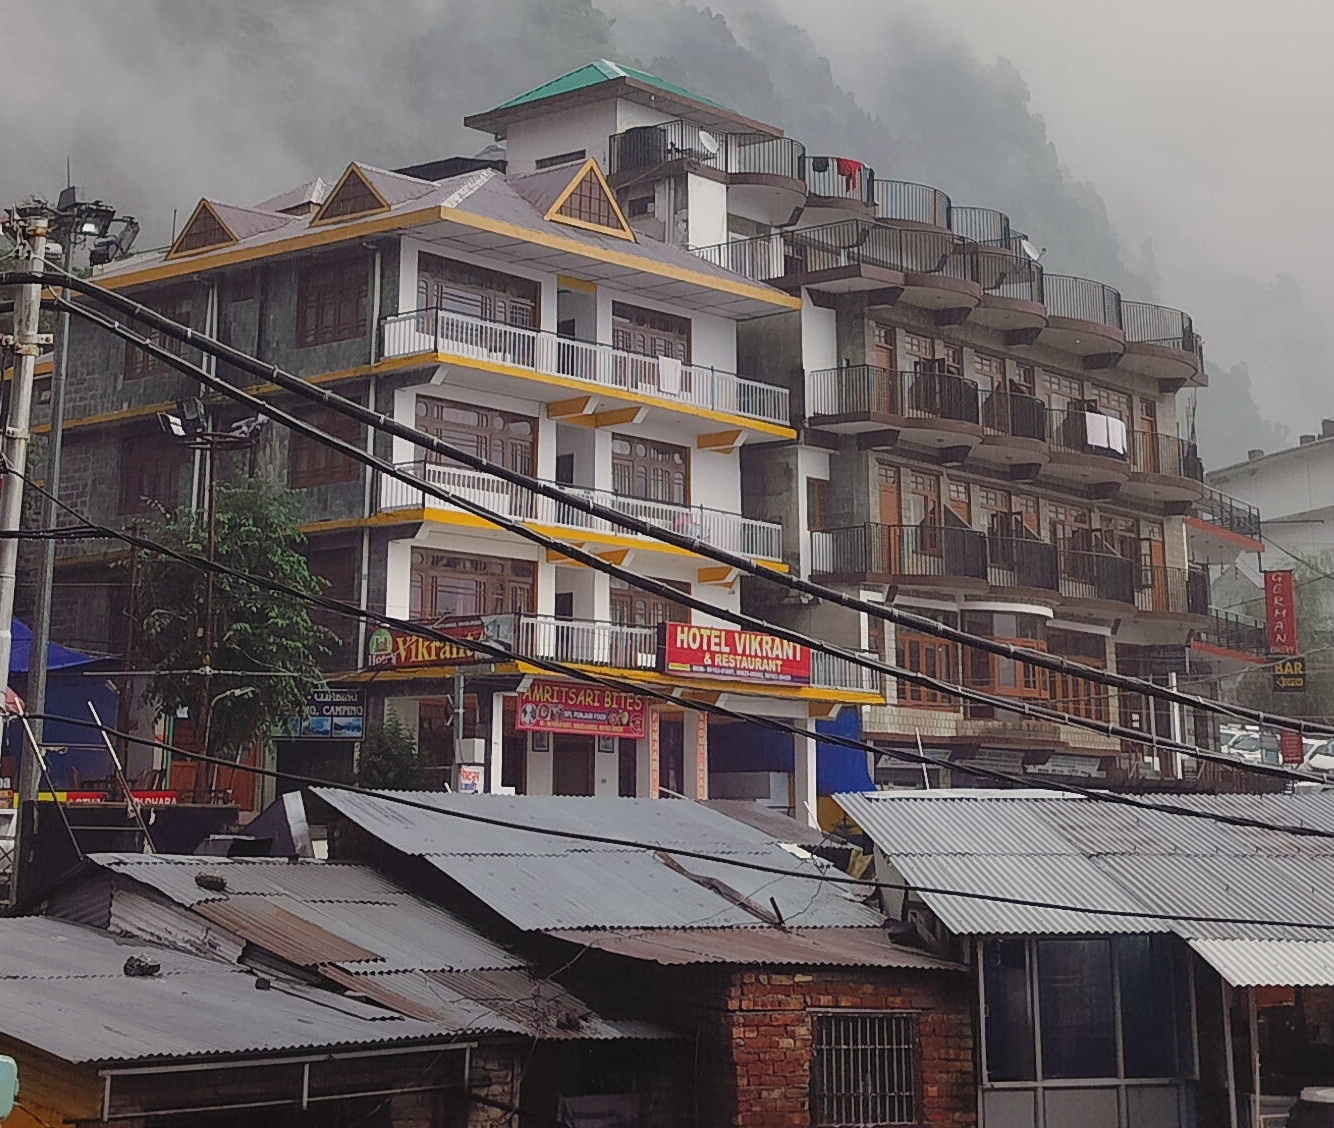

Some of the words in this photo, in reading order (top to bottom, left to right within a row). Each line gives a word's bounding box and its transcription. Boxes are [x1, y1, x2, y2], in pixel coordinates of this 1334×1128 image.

[1271, 572, 1287, 643] GERMAN
[676, 626, 730, 653] HOTEL
[734, 633, 802, 661] VIKRANT
[704, 652, 712, 665] &
[715, 654, 783, 672] RESTAURANT
[1274, 661, 1303, 675] BAR
[523, 684, 600, 707] AMRITSARI
[604, 692, 642, 711] BITES
[323, 705, 363, 716] CAMPING
